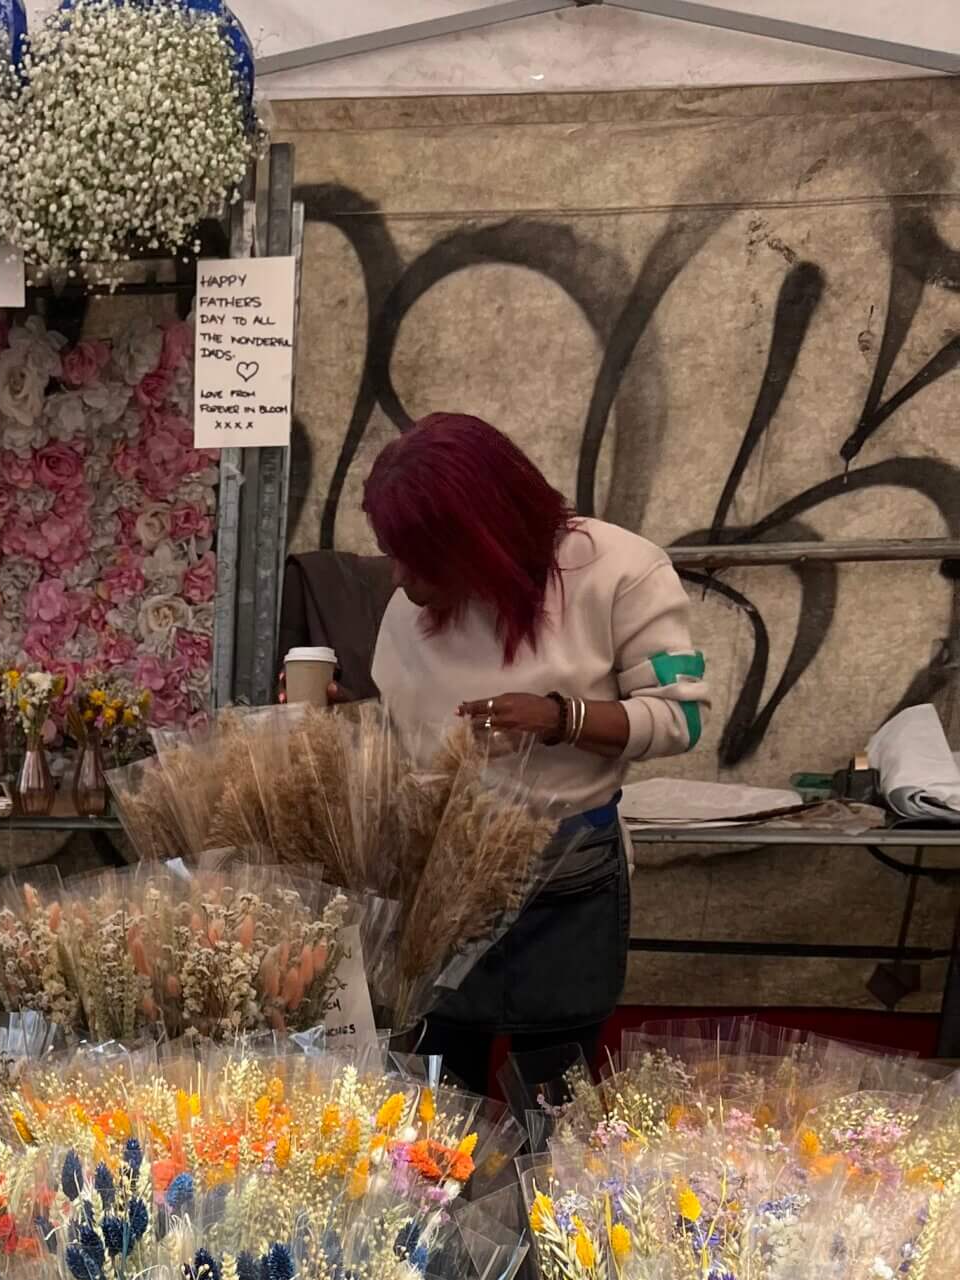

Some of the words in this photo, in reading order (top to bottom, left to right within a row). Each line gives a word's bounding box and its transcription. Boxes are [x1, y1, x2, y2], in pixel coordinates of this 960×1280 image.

[200, 274, 247, 288] HAPPY
[200, 296, 262, 309] FATHERS
[200, 314, 226, 325] DAY
[232, 316, 248, 326] TO
[252, 315, 276, 326] ALL
[200, 332, 223, 344] THE
[230, 335, 292, 348] WONDERFUL
[200, 389, 223, 399] LOVE
[230, 389, 256, 398] FROM
[200, 403, 240, 414] FOREVER
[244, 406, 256, 414] IN
[259, 404, 288, 415] BLOOM
